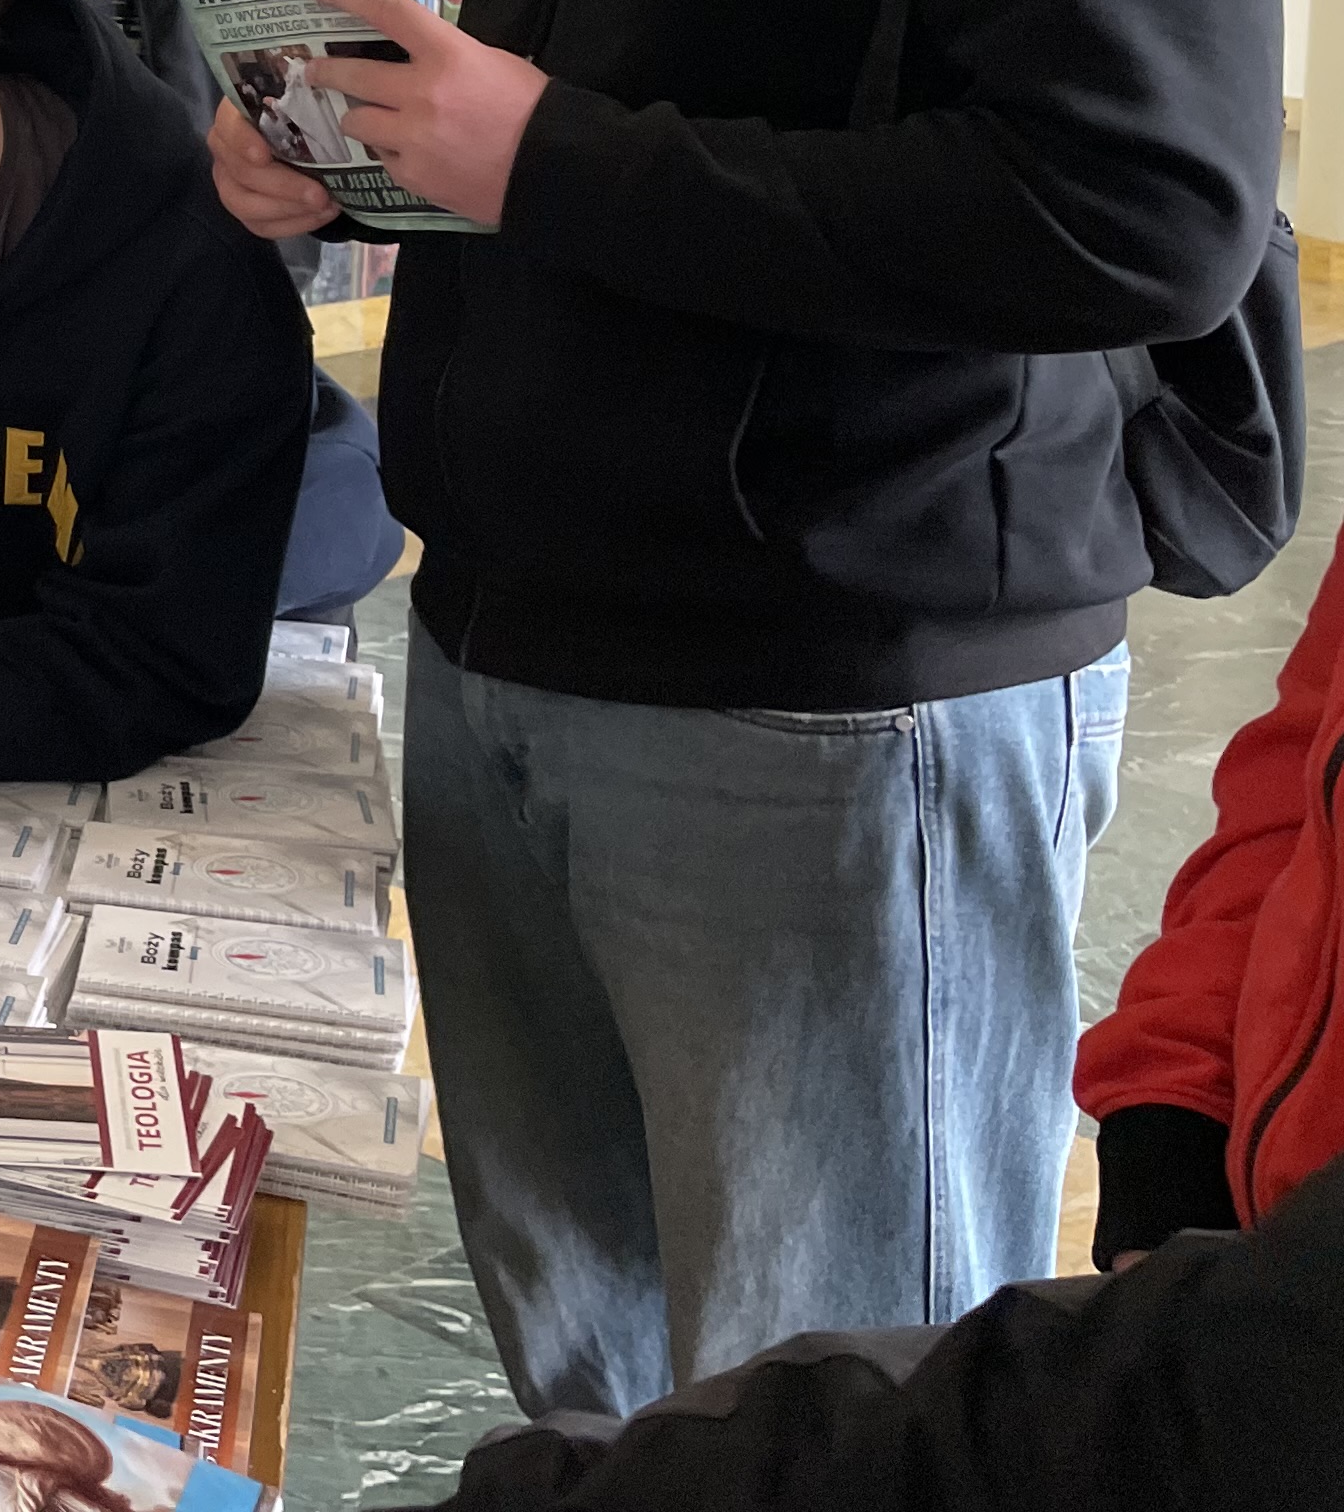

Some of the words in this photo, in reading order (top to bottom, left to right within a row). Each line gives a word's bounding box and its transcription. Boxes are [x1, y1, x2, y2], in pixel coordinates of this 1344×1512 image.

[127, 848, 151, 880] Boży
[141, 931, 165, 966] Boży
[127, 1050, 163, 1152] TEOLOGIA
